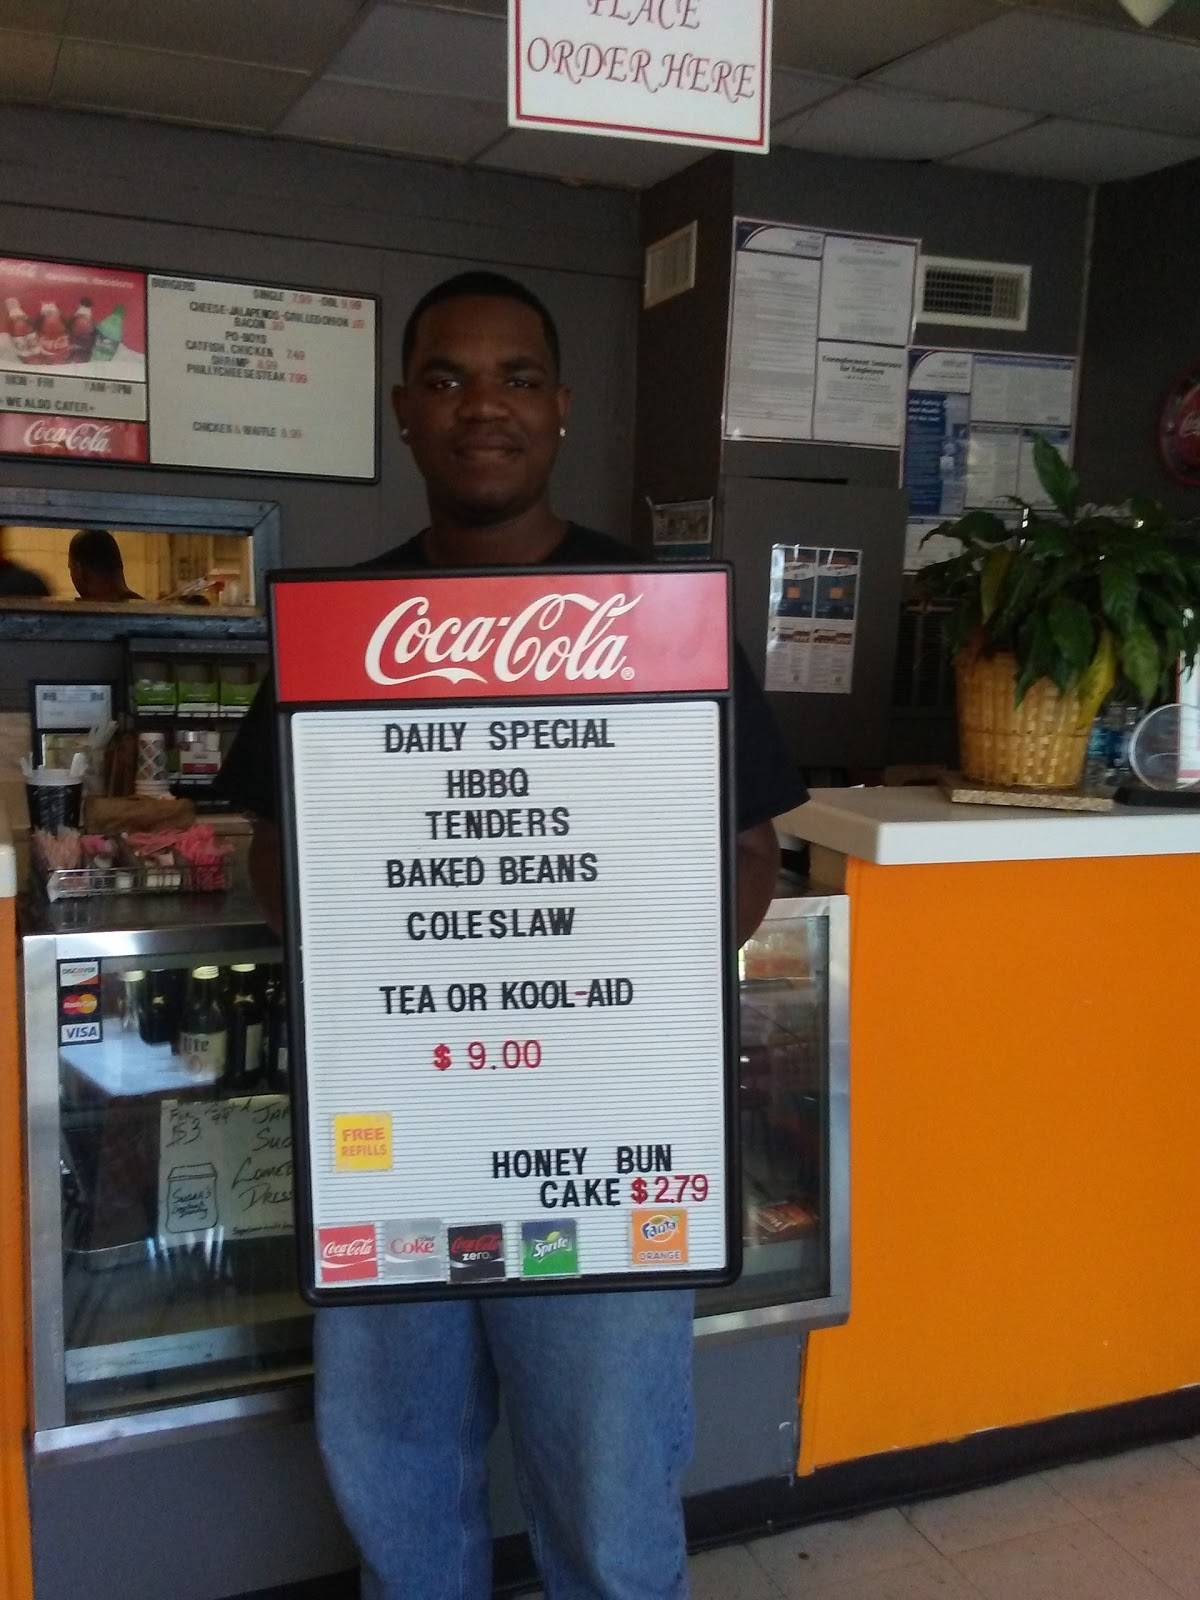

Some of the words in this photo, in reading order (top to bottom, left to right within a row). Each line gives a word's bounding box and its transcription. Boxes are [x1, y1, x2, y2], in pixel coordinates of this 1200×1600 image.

[527, 37, 658, 93] ORDER
[658, 53, 756, 103] HERE
[365, 592, 644, 686] Coca-Cola
[384, 722, 467, 753] DAILY
[489, 718, 616, 750] SPECIAL
[447, 767, 529, 798] HBBQ
[425, 806, 570, 840] TENDERS
[386, 856, 485, 888] BAKED
[499, 852, 599, 885] BEANS
[407, 907, 575, 940] COLESLAW
[379, 985, 437, 1015] TEA
[447, 983, 488, 1012] OR
[501, 977, 634, 1010] KOOL-AID
[67, 1025, 97, 1039] VISA
[467, 1039, 542, 1070] 9.00
[342, 1127, 386, 1142] FREE
[341, 1144, 387, 1158] REFILLS
[492, 1147, 588, 1178] HONEY
[616, 1144, 672, 1175] BUN
[539, 1178, 621, 1208] CAKE
[641, 1219, 679, 1240] Fanta
[322, 1238, 373, 1258] Coca-Cola
[390, 1237, 435, 1254] Coke
[462, 1251, 490, 1261] zero
[532, 1236, 569, 1258] Sprite
